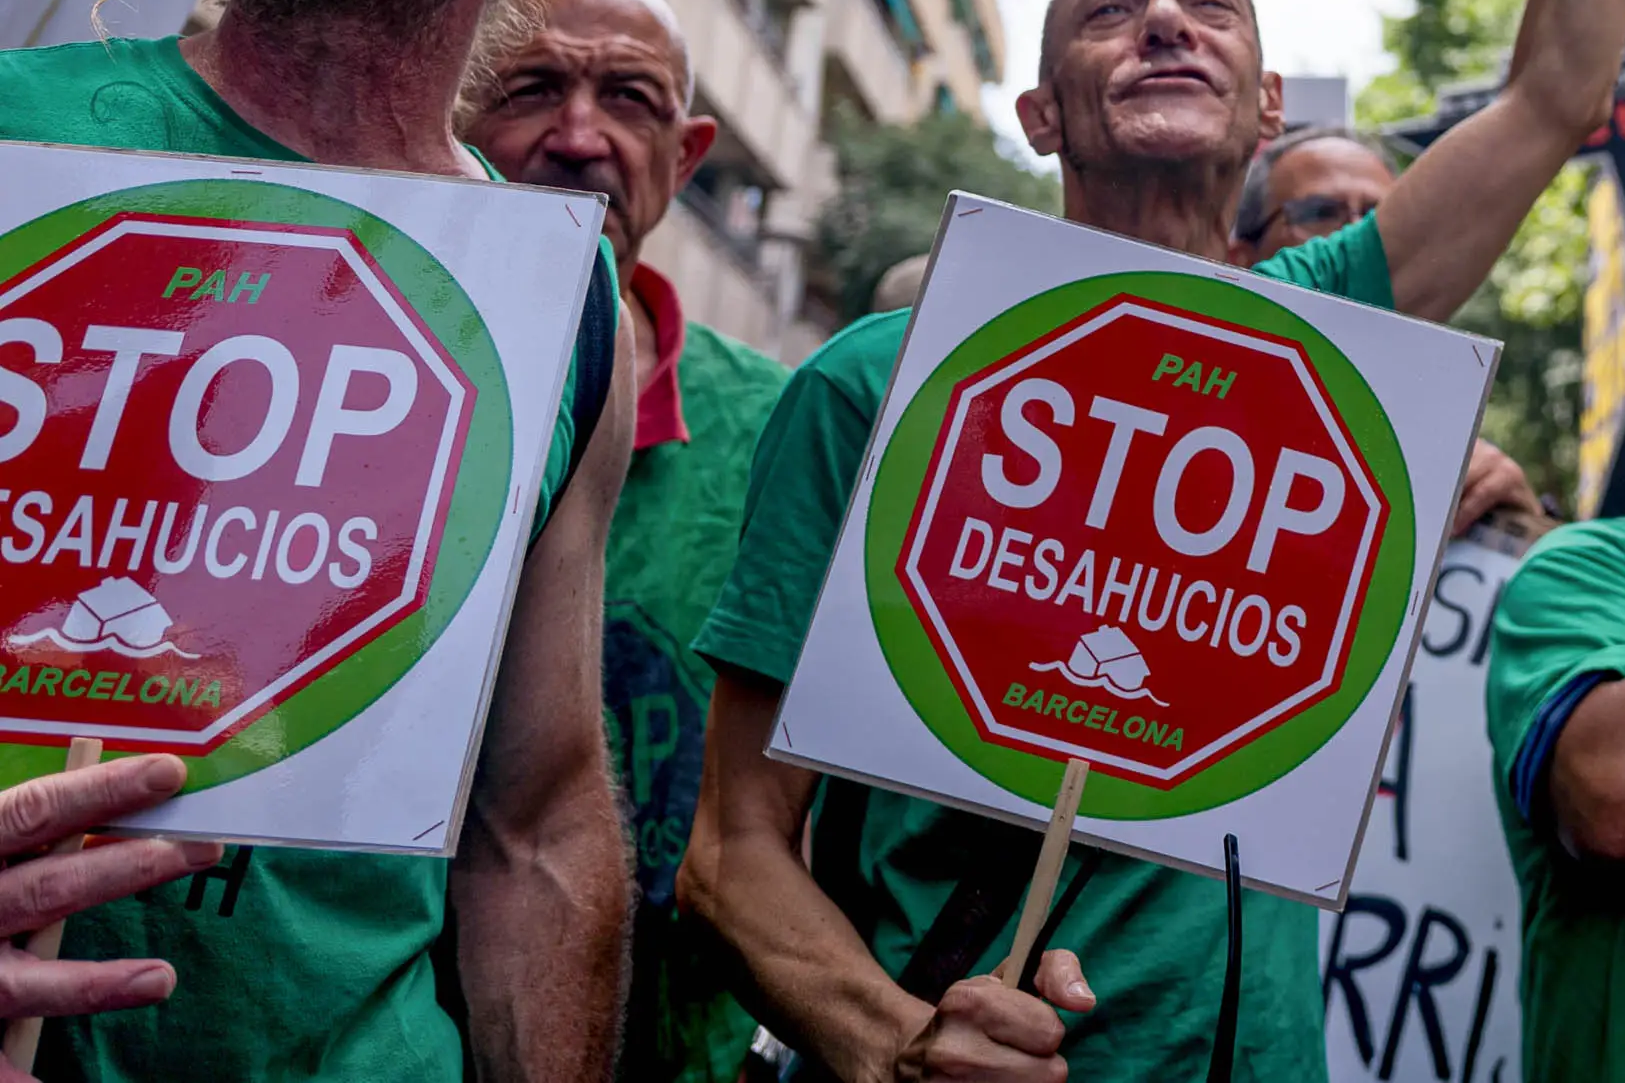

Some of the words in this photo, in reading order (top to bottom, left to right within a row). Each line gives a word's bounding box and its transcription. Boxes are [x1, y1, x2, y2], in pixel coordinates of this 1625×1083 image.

[161, 266, 271, 305] PAH
[1152, 352, 1237, 400] PAH
[981, 377, 1346, 574] STOP
[0, 488, 378, 590] SAHUCIOS
[948, 517, 1307, 668] DESAHUCIOS
[1001, 682, 1185, 753] BARCELONA
